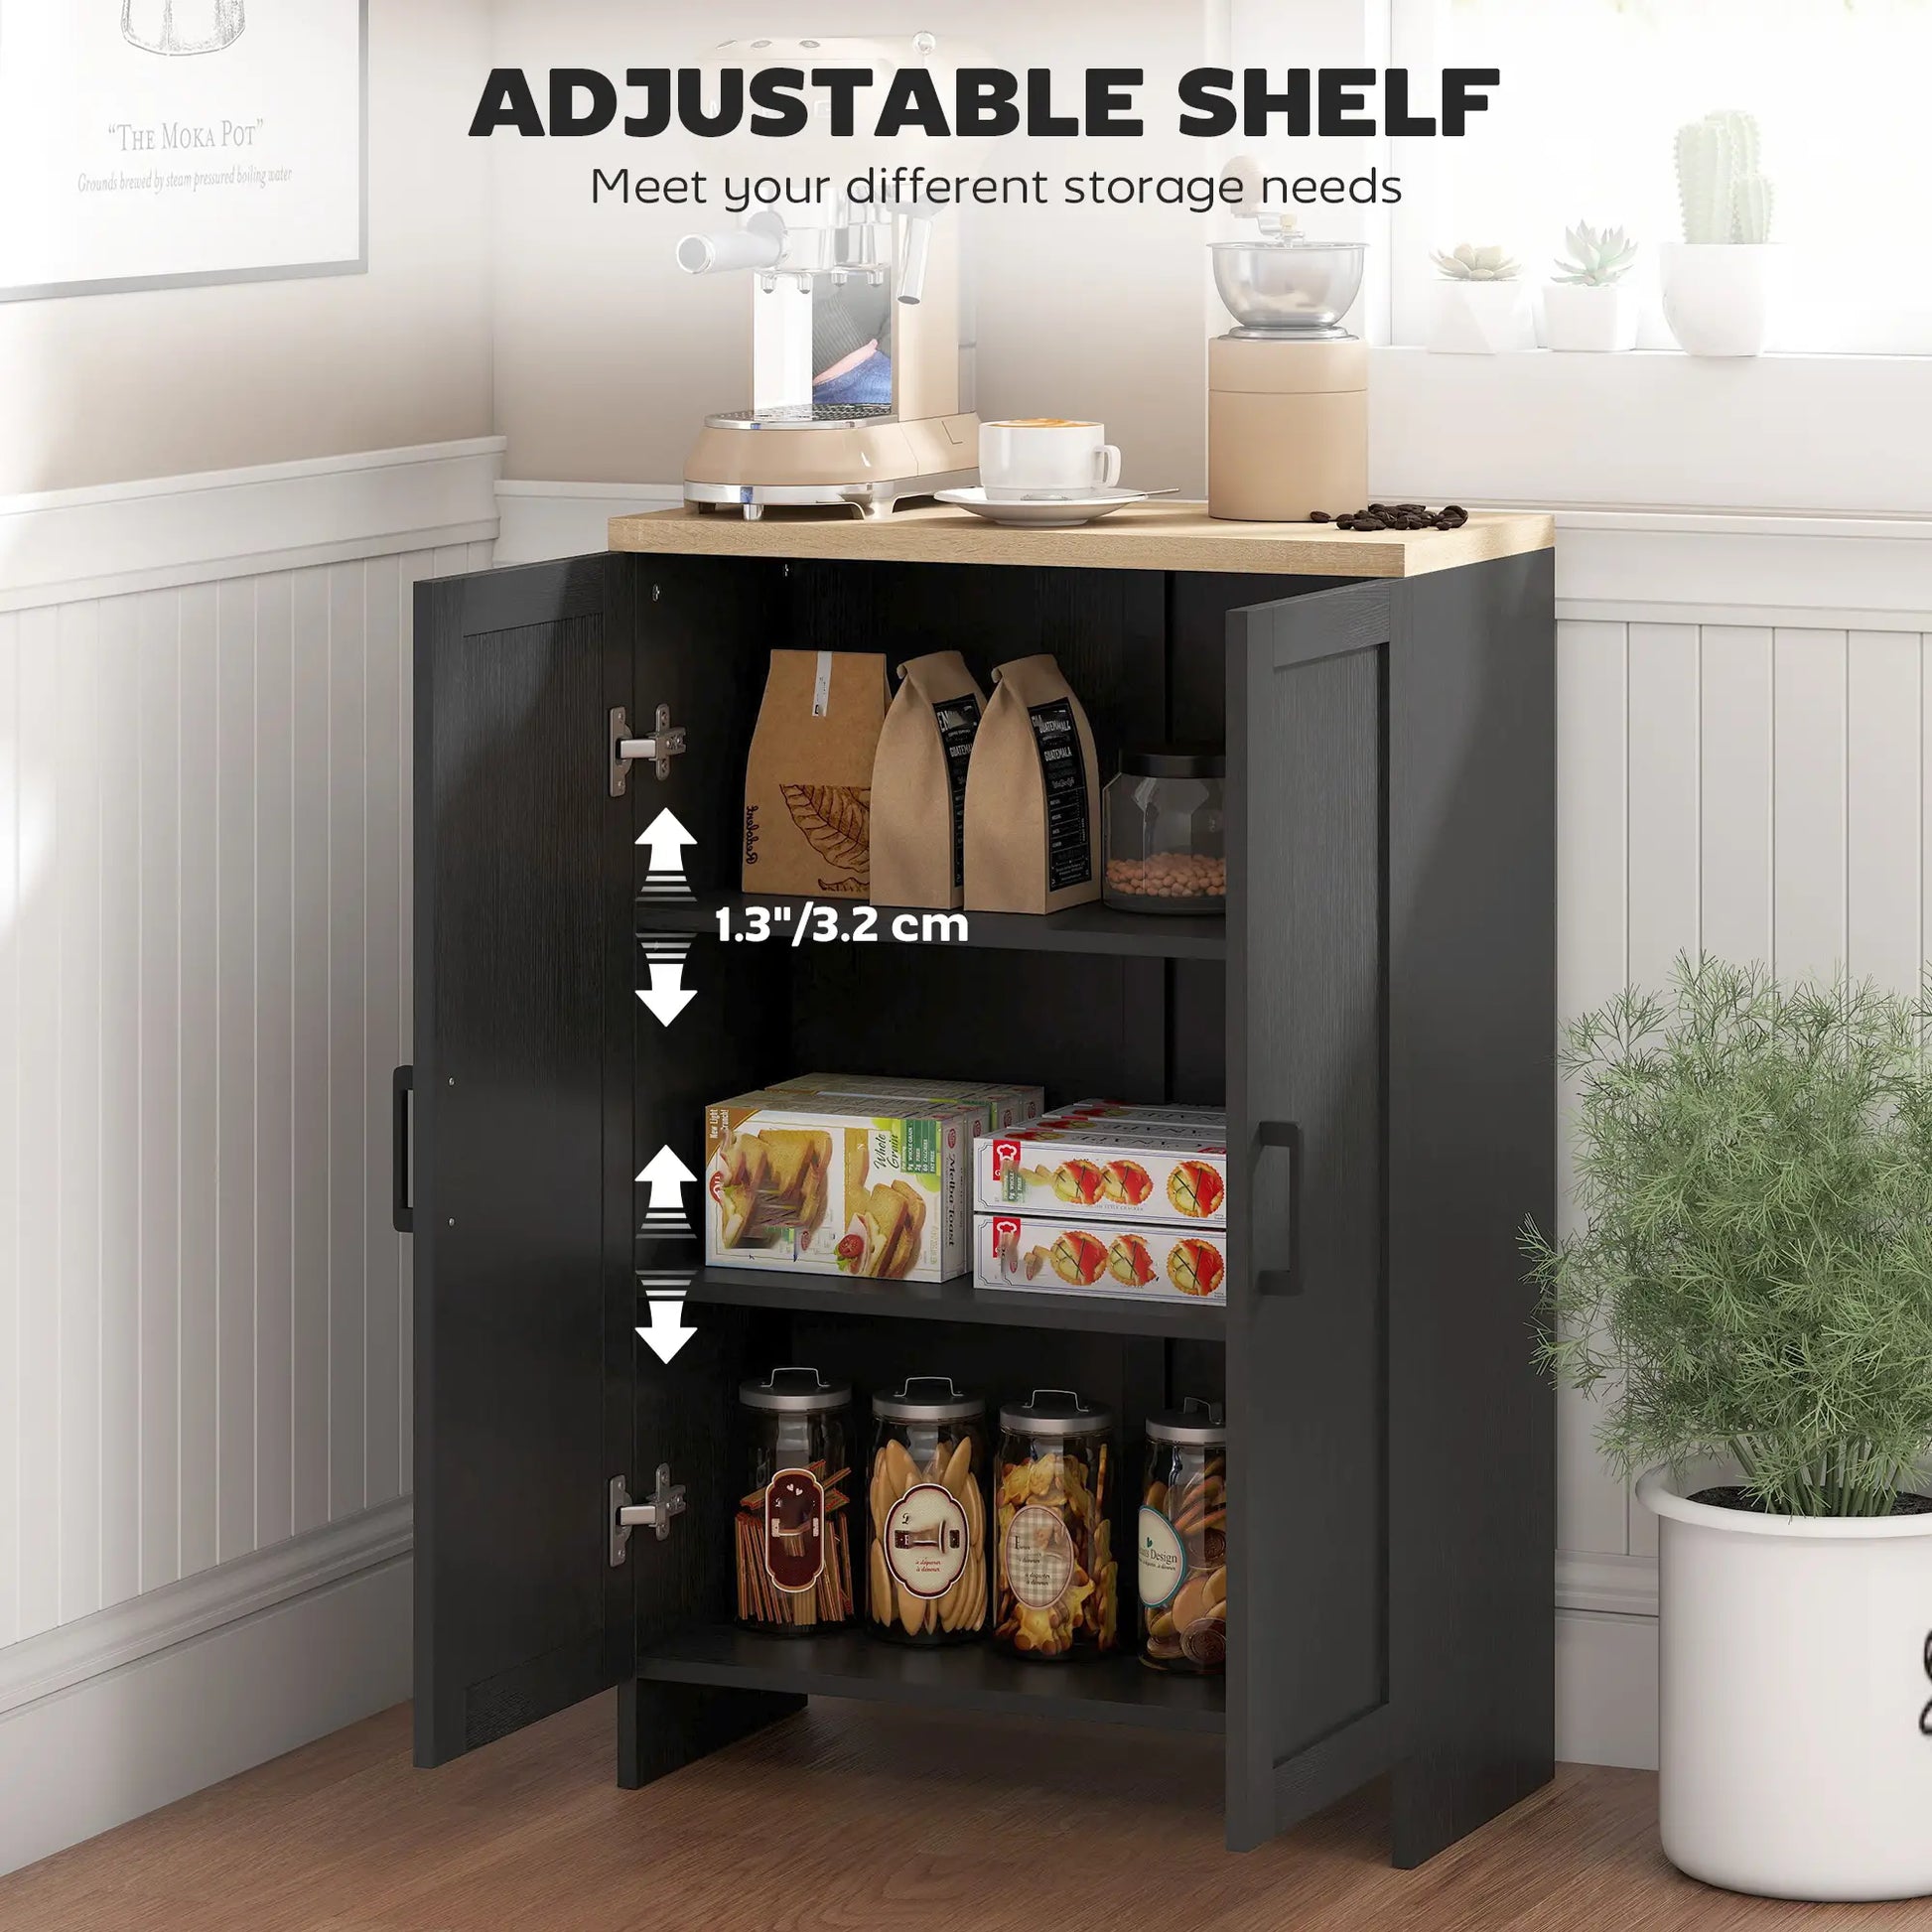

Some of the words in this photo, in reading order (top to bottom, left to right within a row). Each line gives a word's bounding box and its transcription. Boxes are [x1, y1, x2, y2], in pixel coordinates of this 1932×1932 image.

[78, 171, 117, 193] Grounds
[119, 169, 152, 190] brewed
[153, 170, 164, 195] by
[166, 171, 192, 187] steam
[193, 167, 235, 193] pressured
[237, 165, 266, 188] boiling
[268, 168, 292, 184] water
[709, 1109, 720, 1124] Light
[709, 1126, 718, 1139] New
[874, 1134, 888, 1170] Whole
[887, 1134, 899, 1170] Grain
[1151, 1549, 1177, 1566] Design
